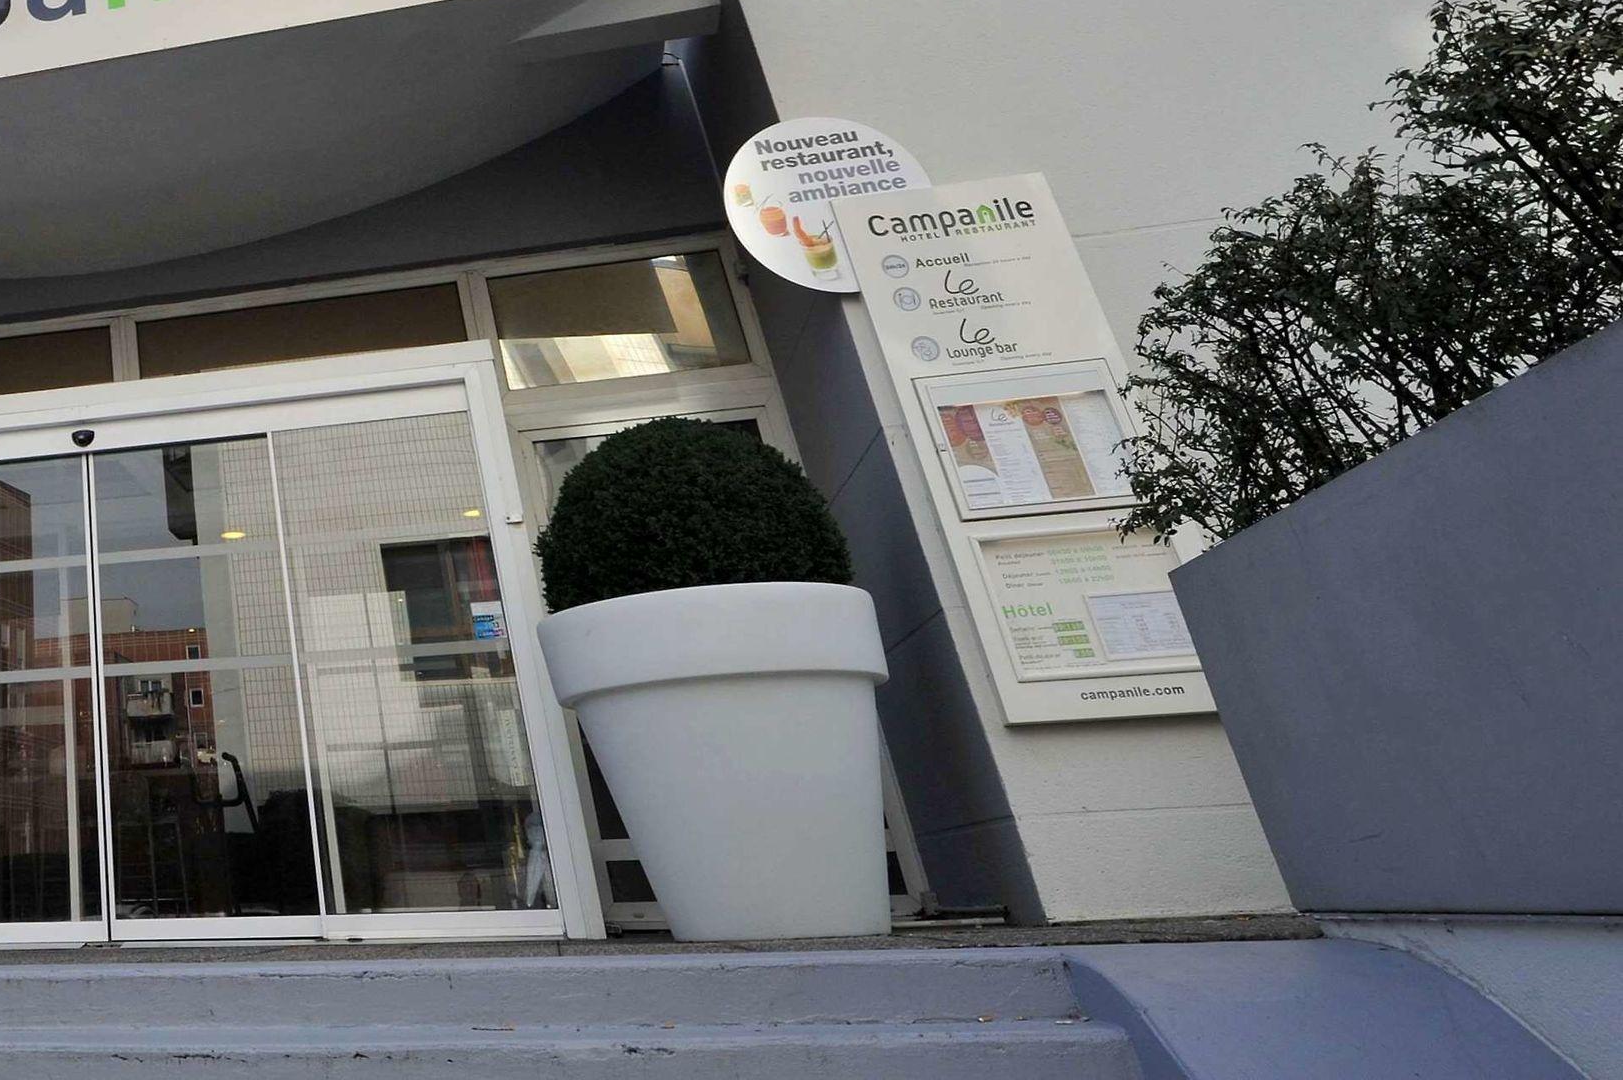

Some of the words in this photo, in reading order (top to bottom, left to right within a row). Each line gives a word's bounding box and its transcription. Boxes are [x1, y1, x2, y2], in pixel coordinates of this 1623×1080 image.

[754, 130, 858, 155] Nouveau
[761, 141, 894, 171] restaurant,
[798, 159, 900, 185] nouvelle
[789, 176, 907, 203] ambiance
[868, 198, 1034, 237] Campanile
[901, 233, 940, 243] HOTEL
[955, 220, 1036, 236] RESTAURANT
[915, 252, 970, 268] Accueil
[944, 269, 980, 295] Le
[929, 291, 1005, 310] Restaurant
[960, 318, 995, 345] Le
[946, 343, 994, 359] Lounge
[996, 342, 1018, 354] bar
[1001, 602, 1053, 619] Hôtel
[1080, 684, 1186, 701] campanile.com
